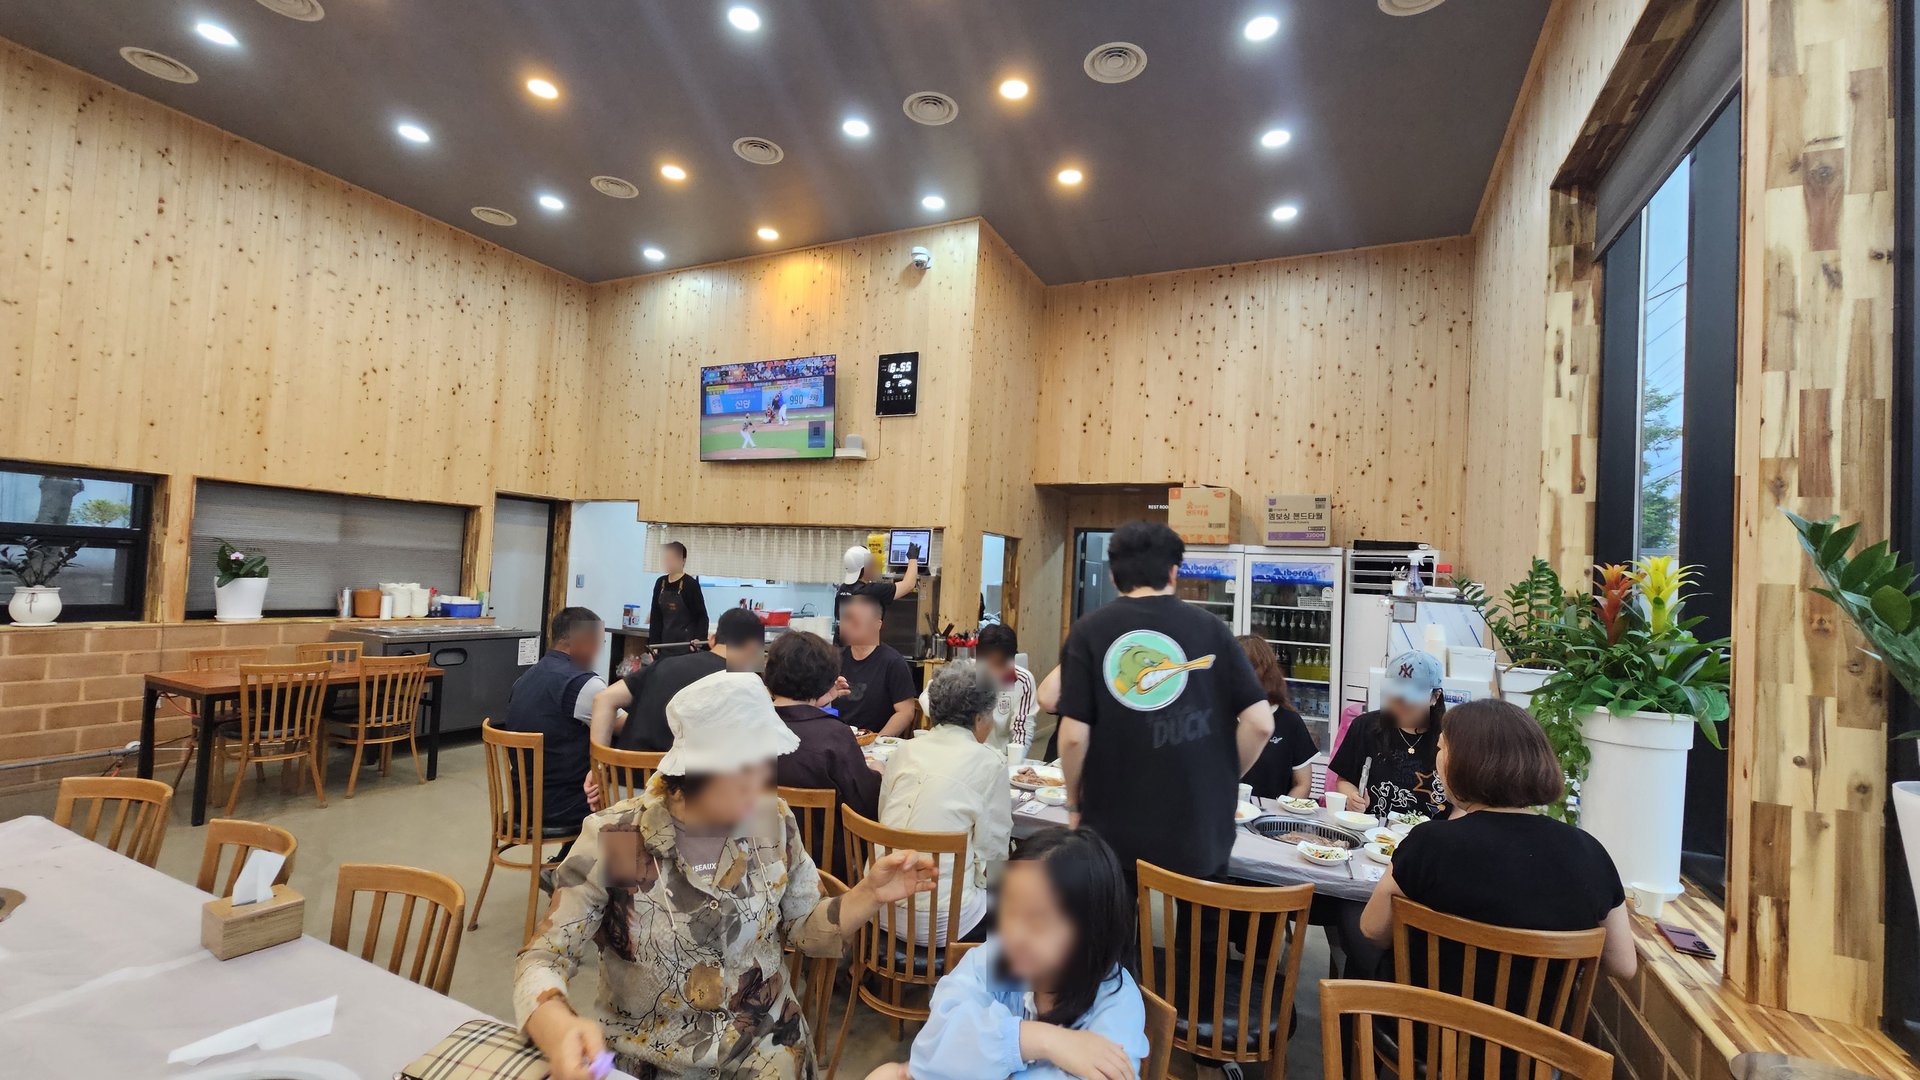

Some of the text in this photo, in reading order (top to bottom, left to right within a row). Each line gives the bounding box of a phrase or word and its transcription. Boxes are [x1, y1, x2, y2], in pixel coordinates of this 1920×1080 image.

[789, 394, 804, 405] 990
[1268, 512, 1323, 520] 엠보싱 핸드타월
[1398, 662, 1414, 679] NY
[1153, 708, 1213, 748] DUCK
